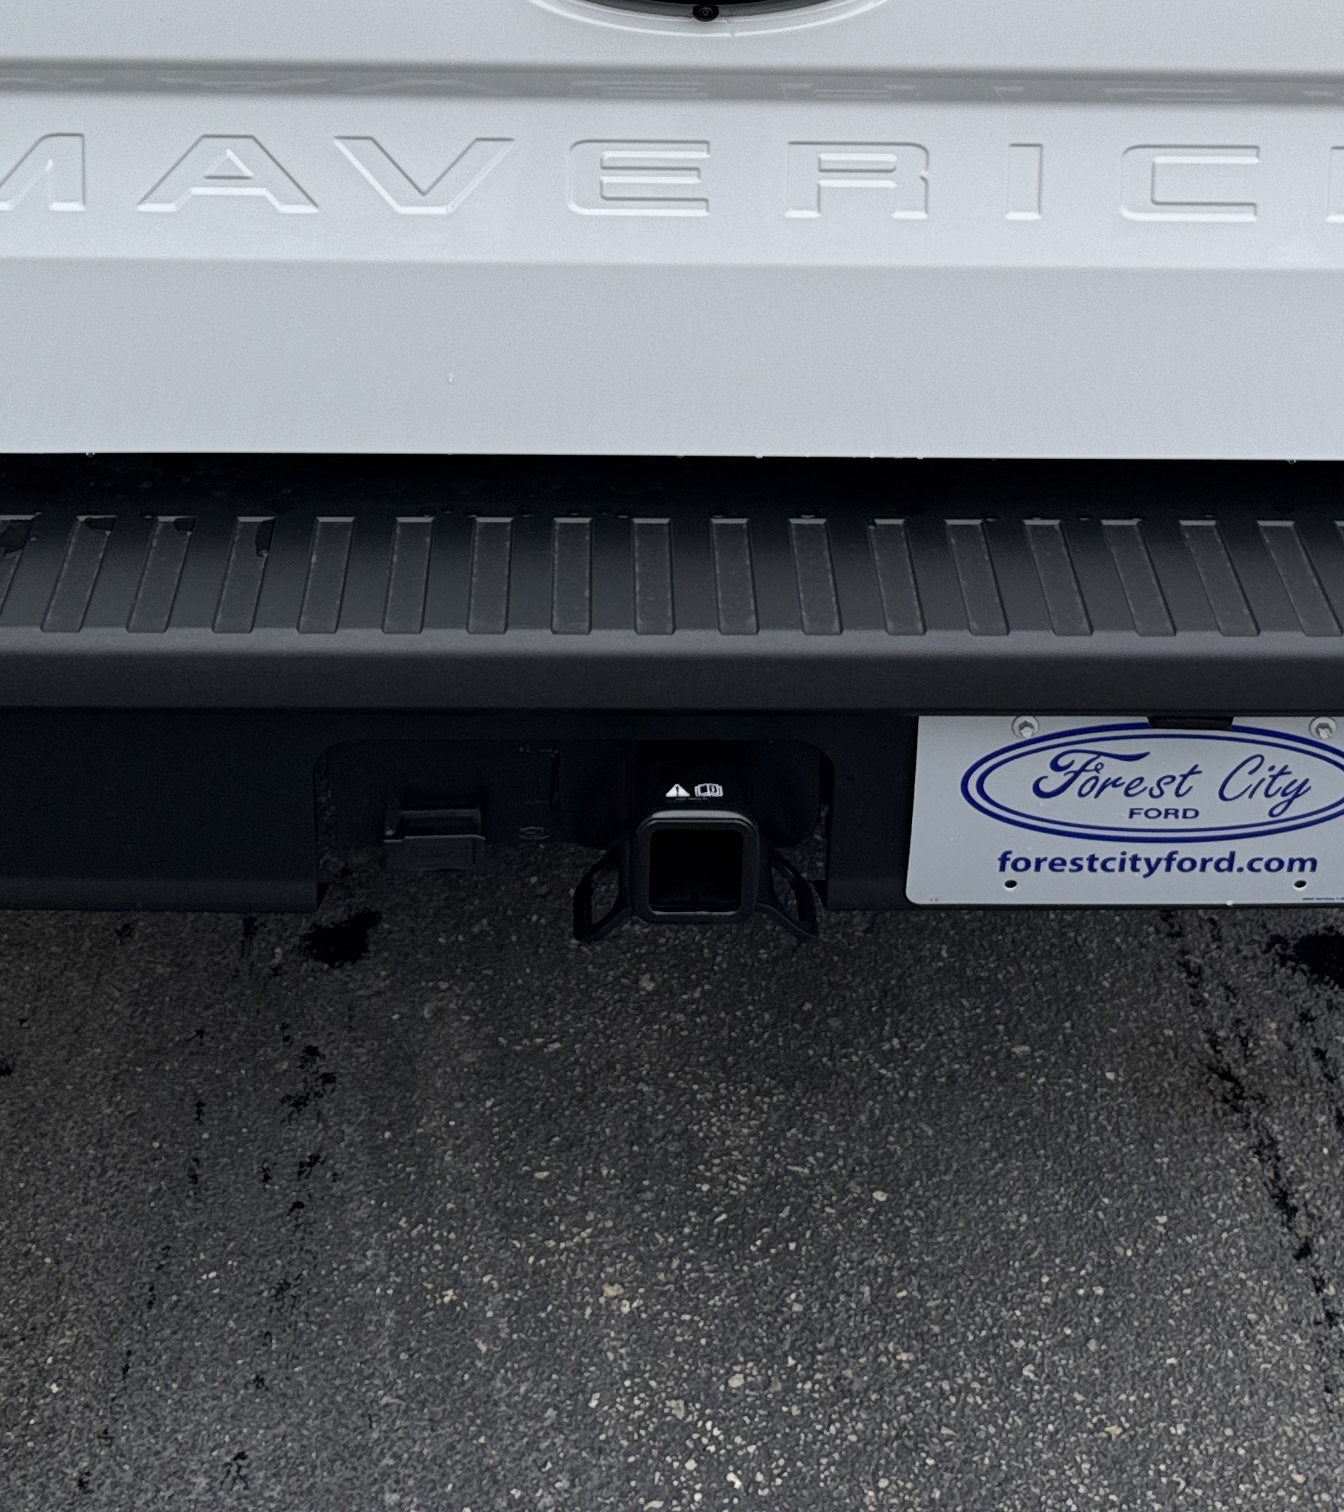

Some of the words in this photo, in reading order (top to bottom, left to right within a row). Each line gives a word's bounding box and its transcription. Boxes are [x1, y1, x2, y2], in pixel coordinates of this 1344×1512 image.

[1032, 749, 1203, 799] Forest
[1217, 753, 1312, 818] City
[1127, 807, 1200, 819] FORD
[997, 850, 1318, 878] forestcityford.com
